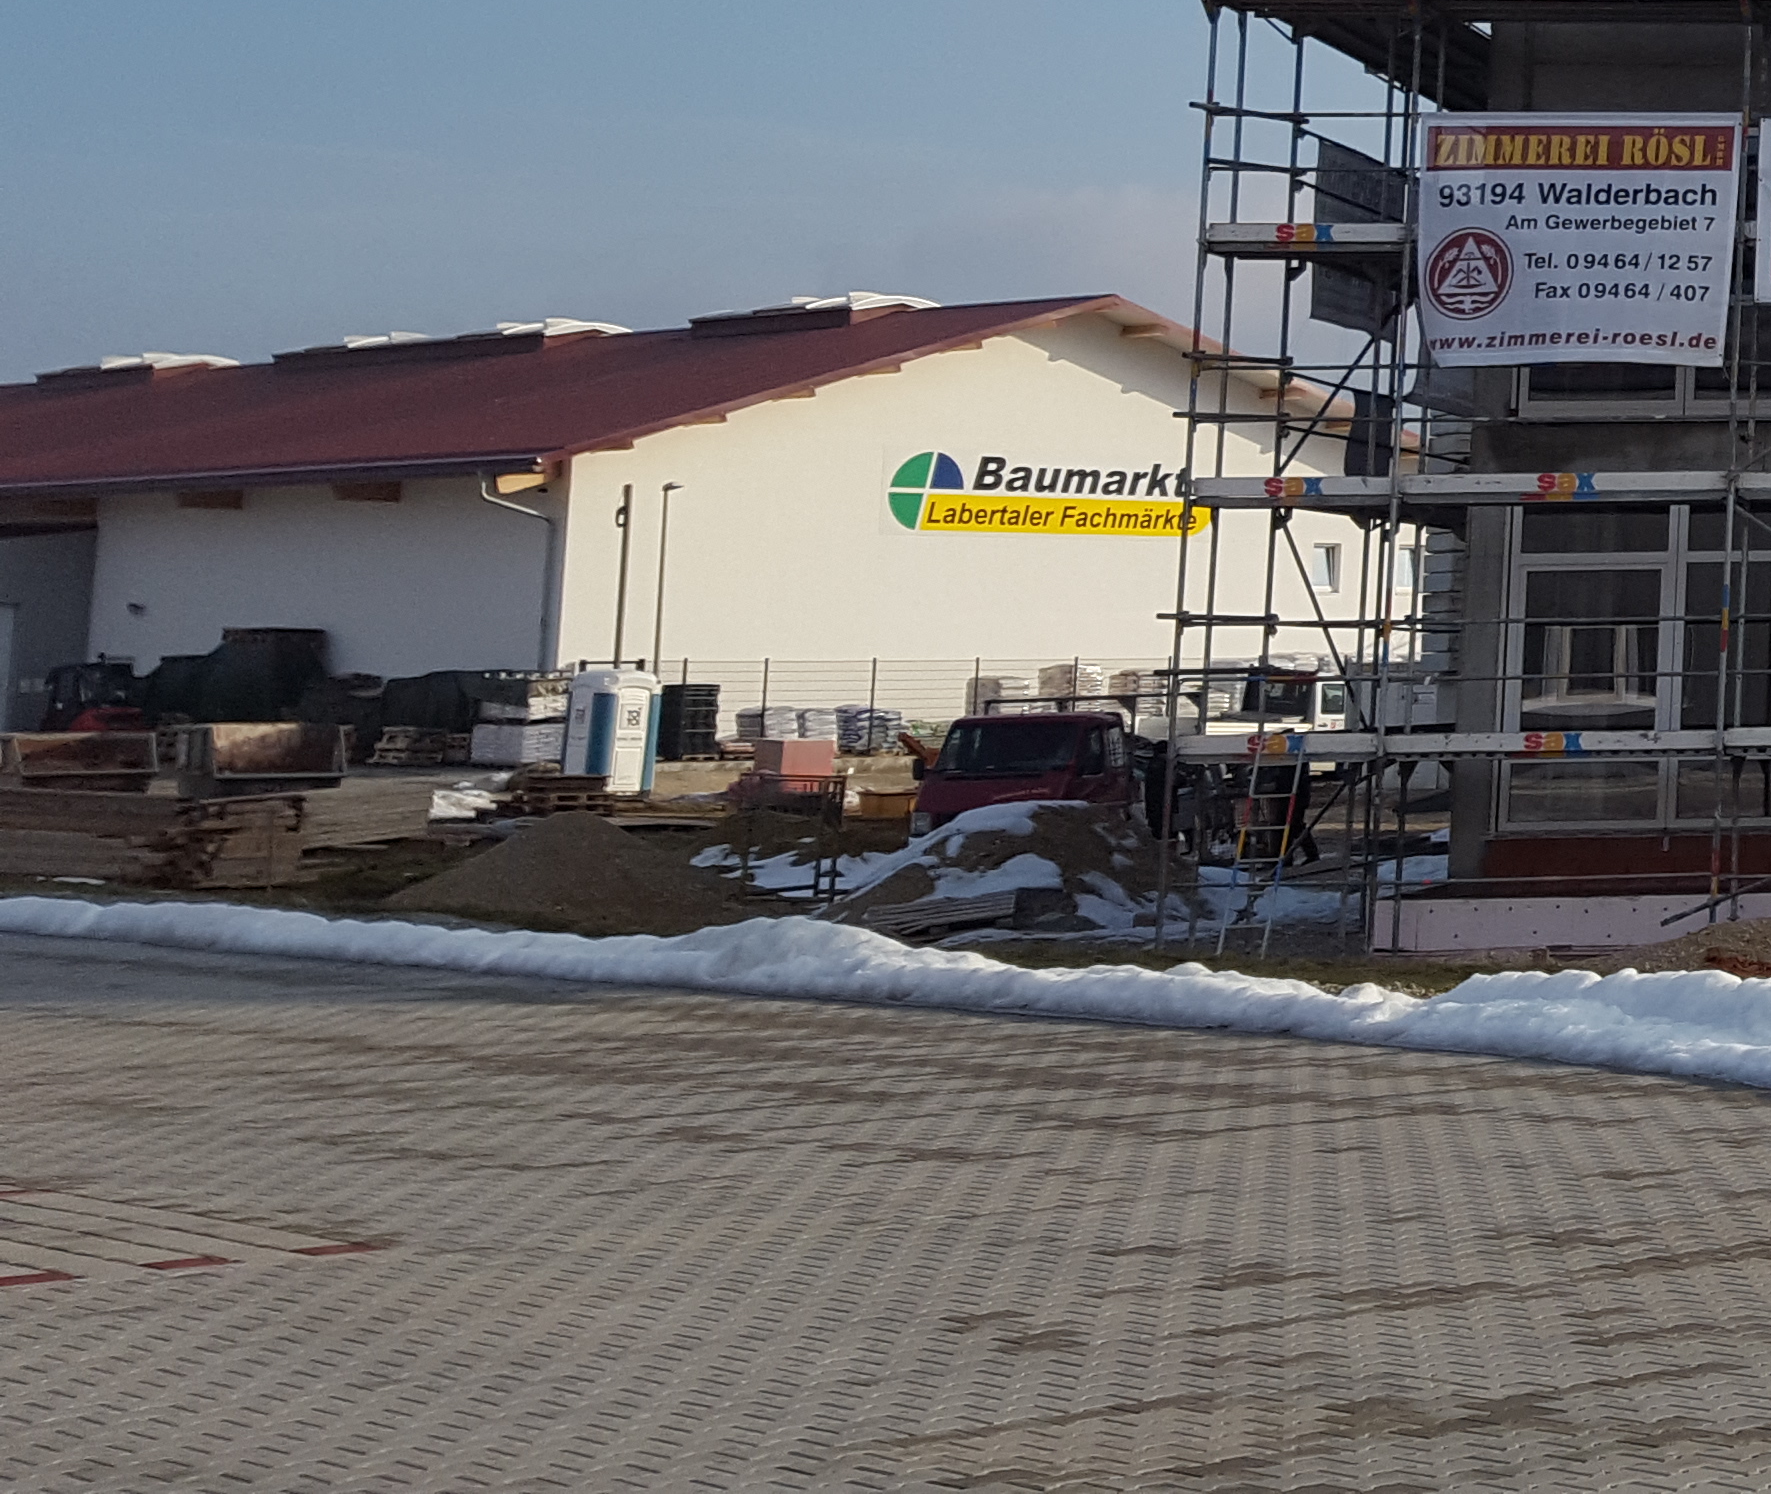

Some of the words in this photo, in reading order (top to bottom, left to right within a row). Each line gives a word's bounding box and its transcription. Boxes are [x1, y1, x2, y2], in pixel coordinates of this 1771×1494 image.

[1436, 133, 1610, 166] ZIMMEREI
[1621, 129, 1712, 166] RÖSL
[1439, 183, 1526, 207] 93194
[1538, 182, 1718, 206] Walderbach
[1276, 224, 1334, 241] sax
[1505, 214, 1538, 231] Am
[1545, 214, 1698, 234] Gewerbegebiet
[1704, 217, 1715, 231] 7
[1524, 253, 1558, 269] Tel.
[1535, 283, 1570, 299] Fax
[973, 455, 1190, 499] Baumarkt
[1264, 477, 1322, 495] sax
[1537, 473, 1597, 491] sax
[926, 501, 1054, 525] Labertaler
[1060, 506, 1197, 531] Fachmärkte
[1524, 733, 1582, 750] sax
